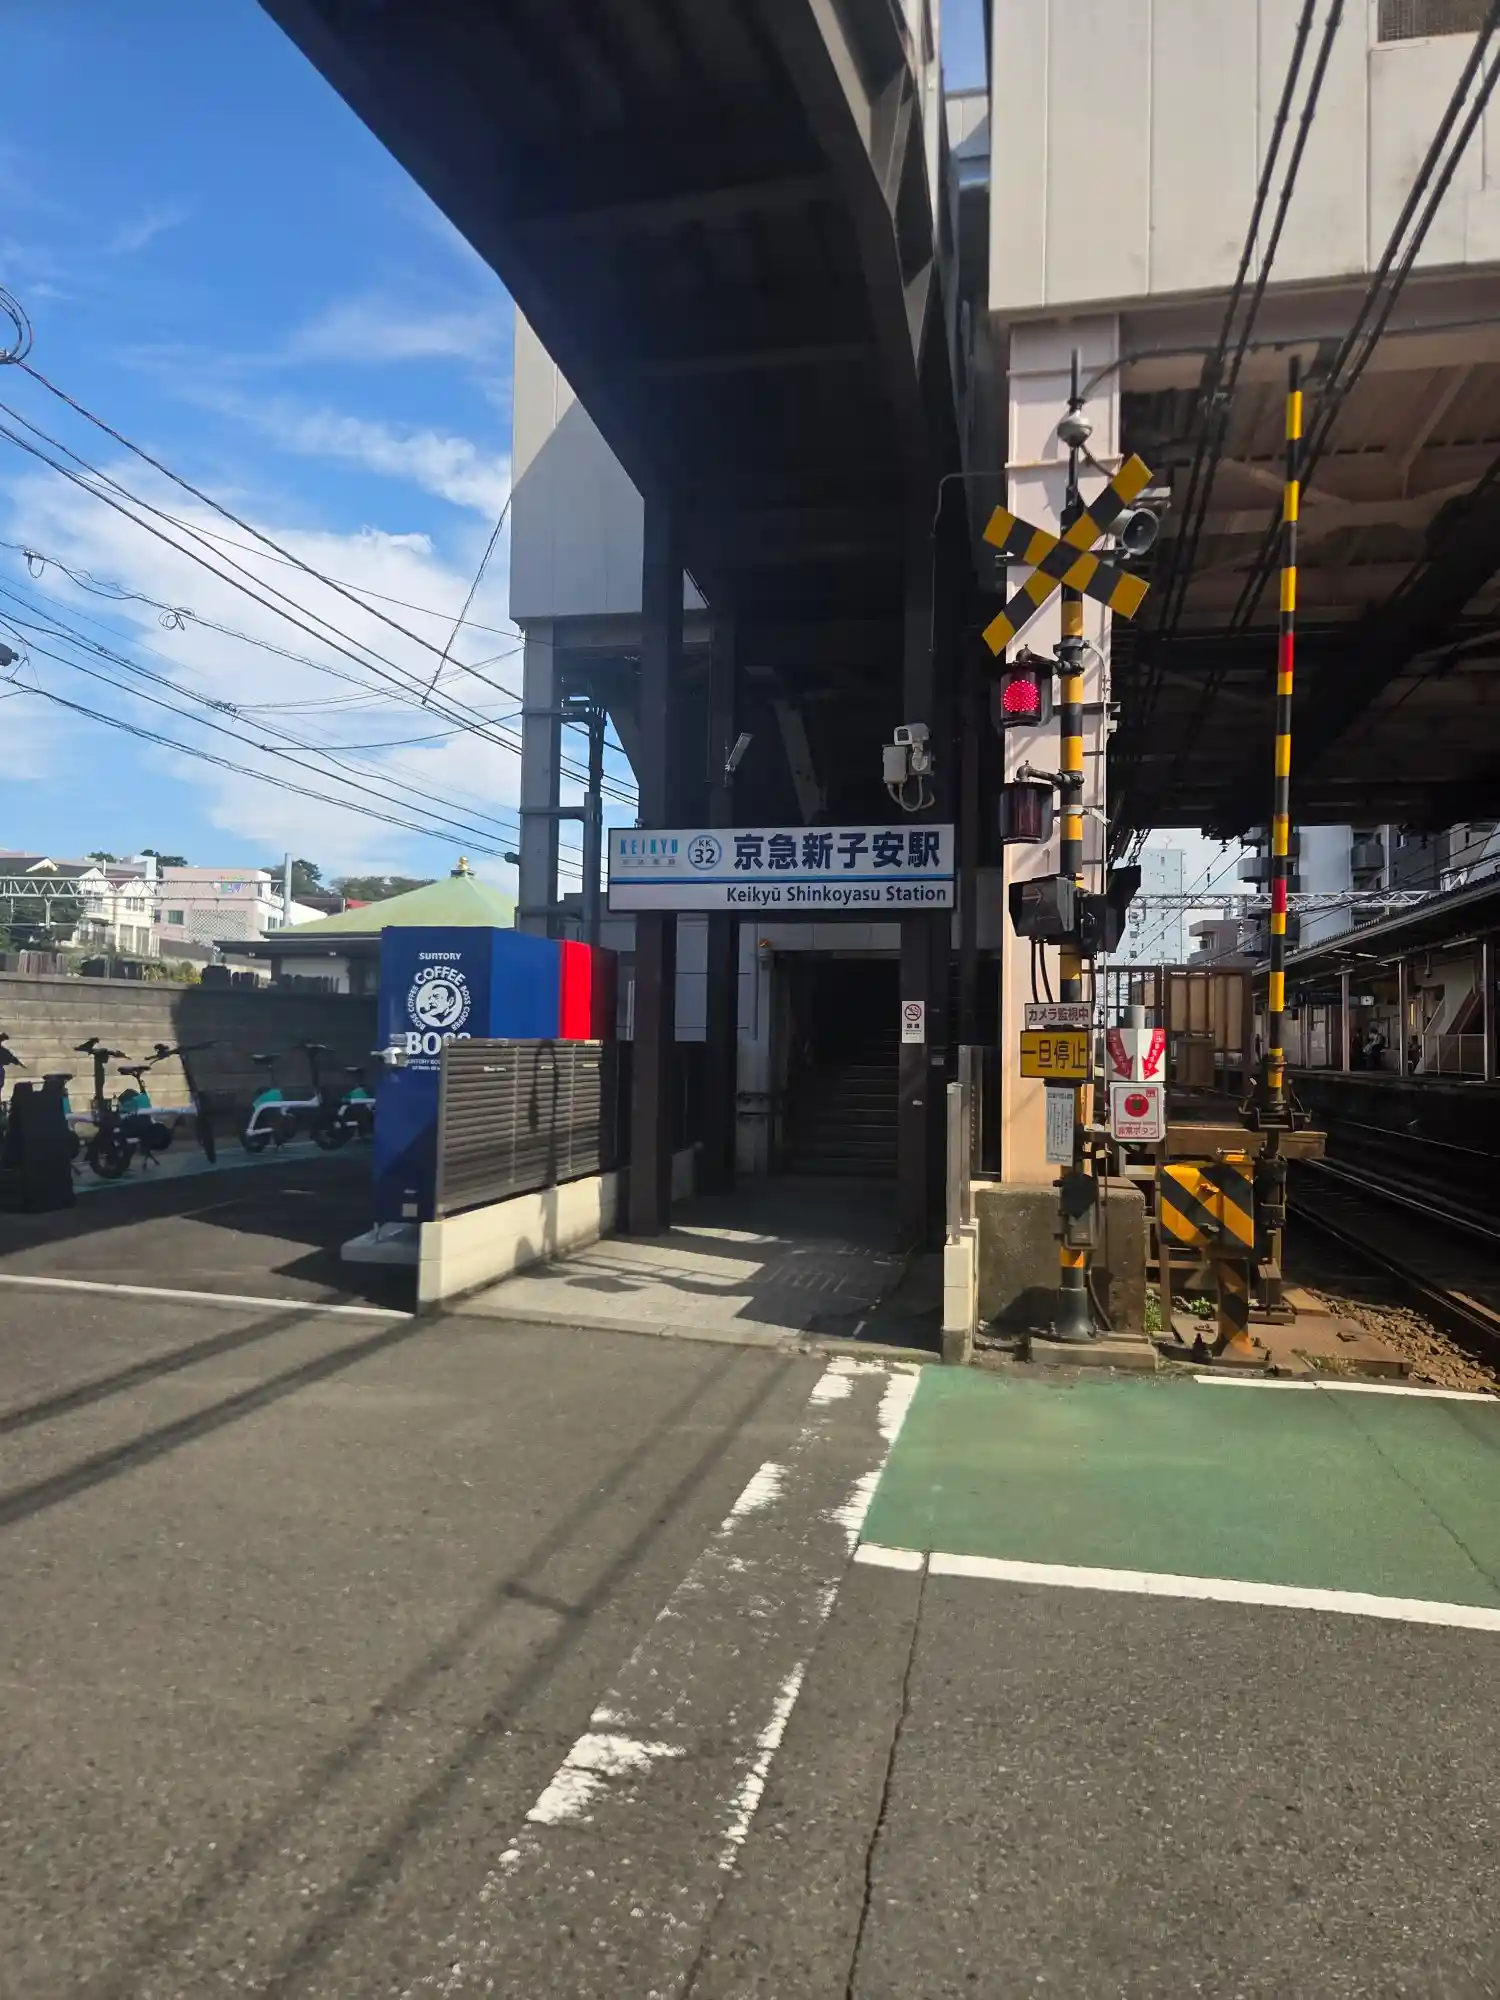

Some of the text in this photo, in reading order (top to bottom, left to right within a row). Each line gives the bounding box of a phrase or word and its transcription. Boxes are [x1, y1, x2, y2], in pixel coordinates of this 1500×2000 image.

[620, 838, 679, 855] KEIKYU
[698, 839, 712, 847] KK
[733, 831, 940, 870] 京急新子安駅
[694, 848, 716, 864] 32
[727, 885, 946, 905] Keikyū Shinkoyasu Station
[419, 952, 462, 960] SUNTORY
[414, 965, 466, 986] COFFEE
[407, 985, 426, 1031] BOSS COFFEE
[451, 985, 472, 1031] BOSS COFFEE
[1028, 1006, 1089, 1021] カメラ監視中
[1021, 1039, 1087, 1069] 一旦停止
